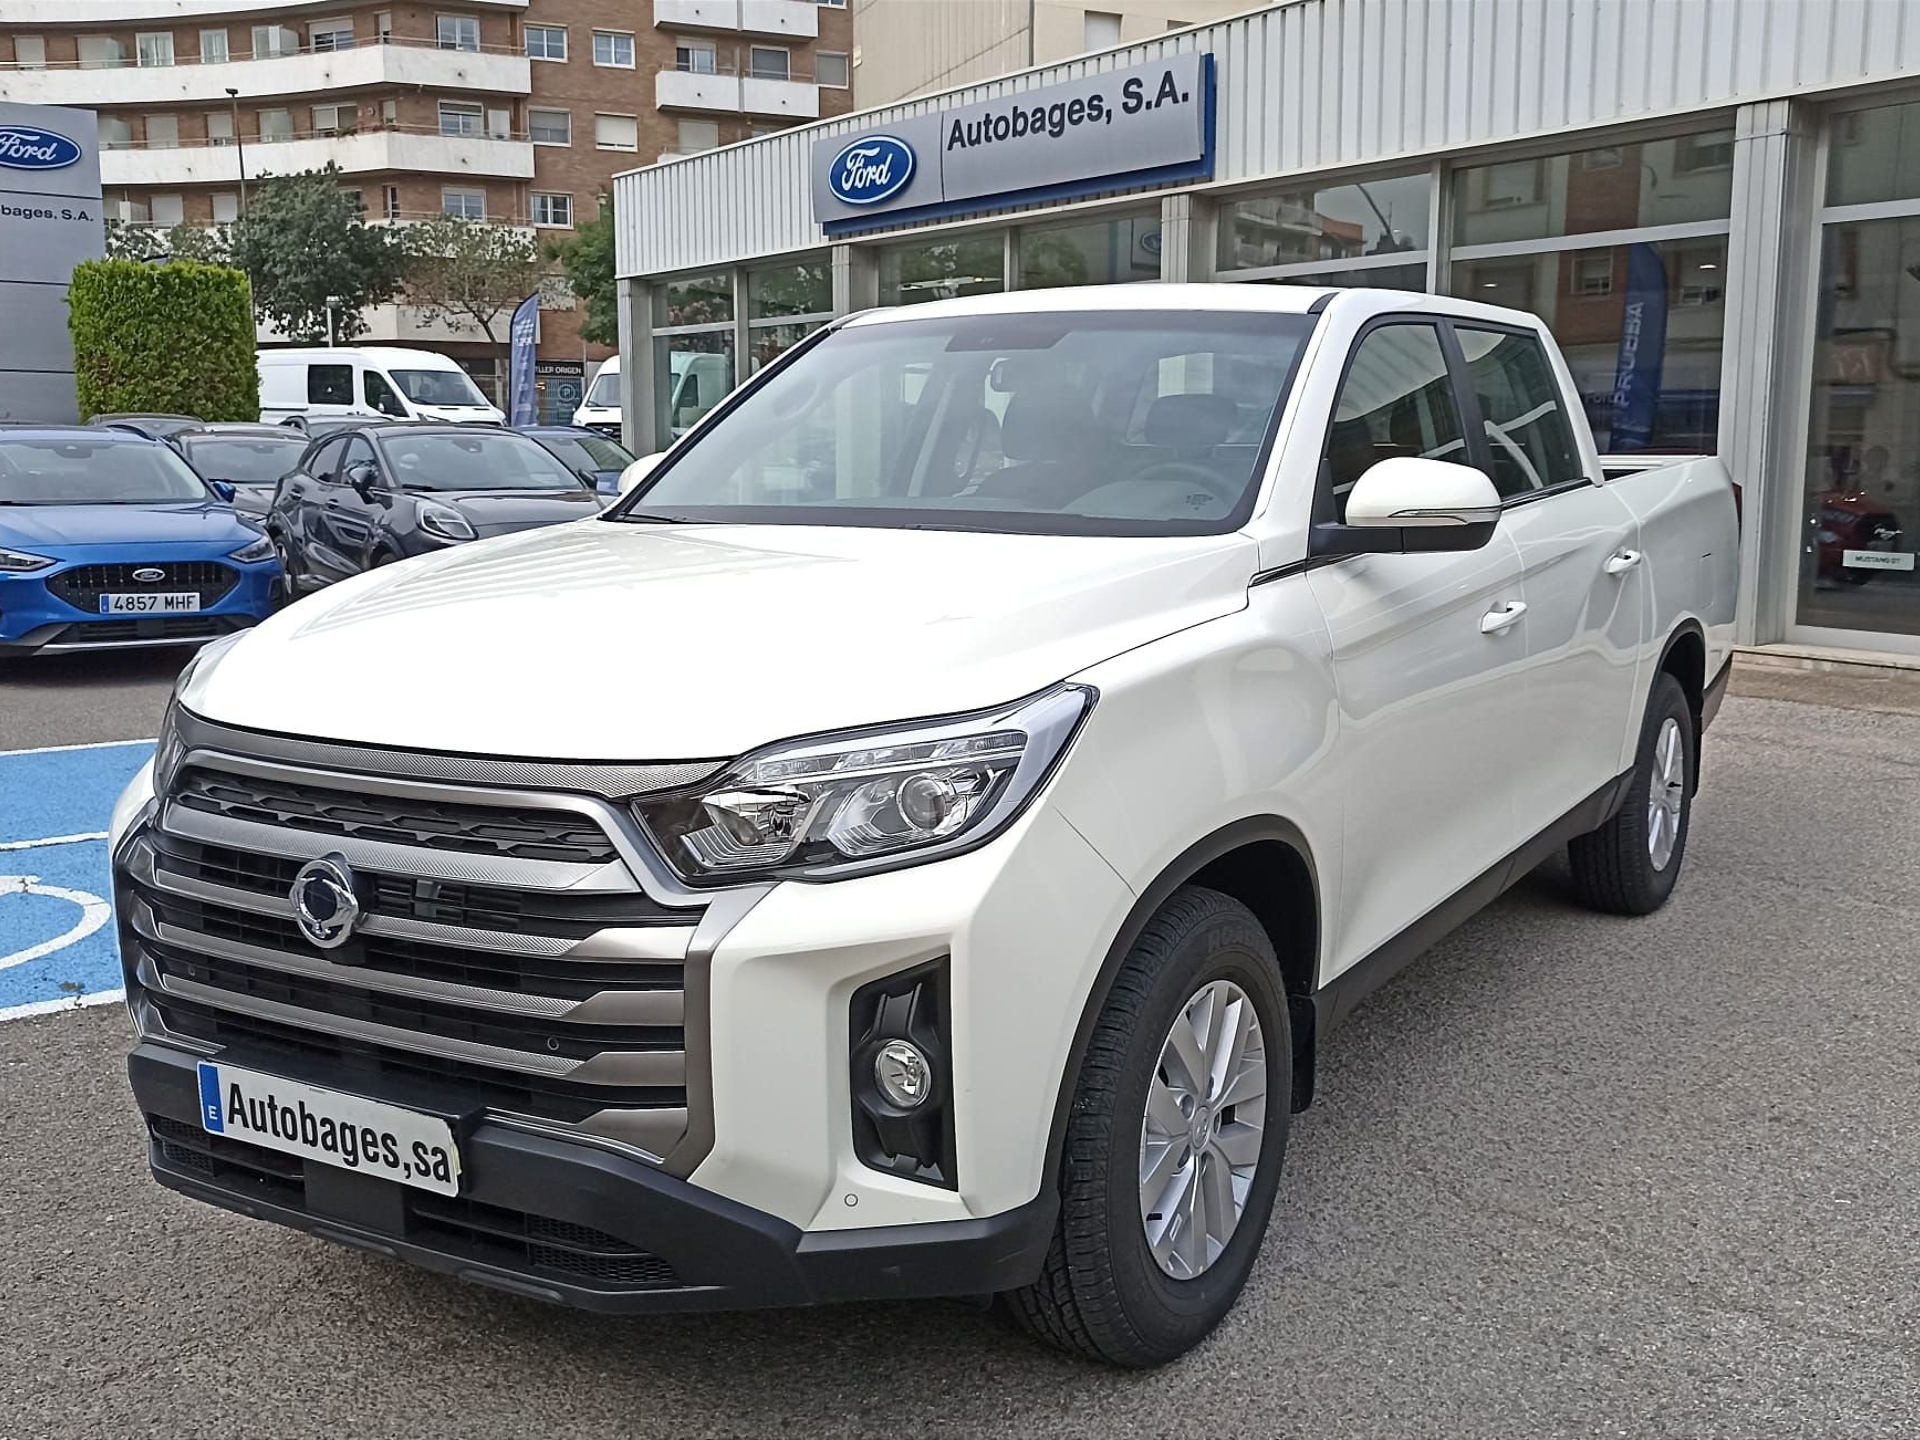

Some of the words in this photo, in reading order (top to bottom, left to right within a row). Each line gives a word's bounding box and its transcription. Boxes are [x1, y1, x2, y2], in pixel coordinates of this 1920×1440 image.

[947, 93, 1112, 151] Autobages,
[1121, 70, 1190, 115] S.A.
[841, 146, 892, 190] Ford
[61, 208, 94, 222] S.A.
[113, 595, 158, 611] 4857
[164, 594, 197, 610] MHF
[207, 1105, 218, 1120] E
[228, 1082, 452, 1183] Autobages,sa
